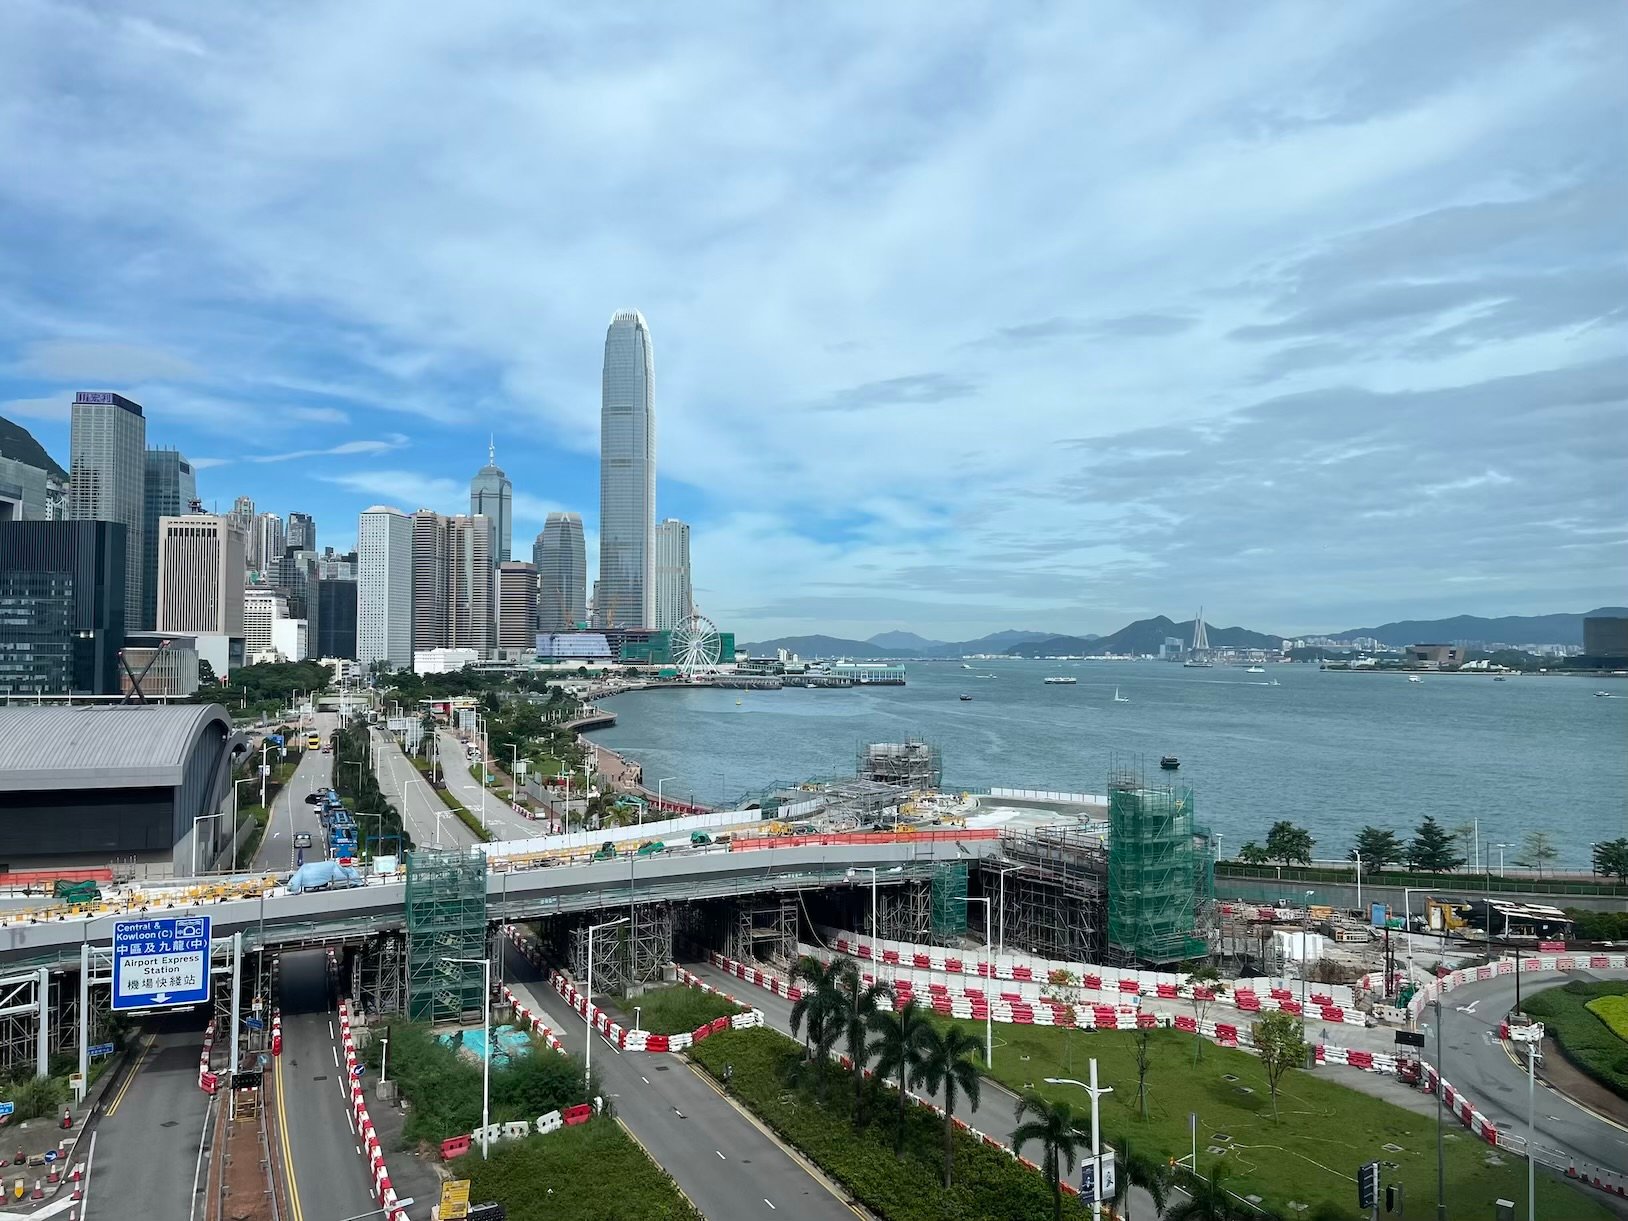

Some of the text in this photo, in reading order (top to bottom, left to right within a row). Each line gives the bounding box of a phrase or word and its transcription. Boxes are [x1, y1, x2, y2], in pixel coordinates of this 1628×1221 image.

[117, 922, 161, 932] Central &
[116, 930, 173, 941] Kowloon (C)
[124, 956, 200, 967] Airport Express
[144, 966, 180, 974] Station
